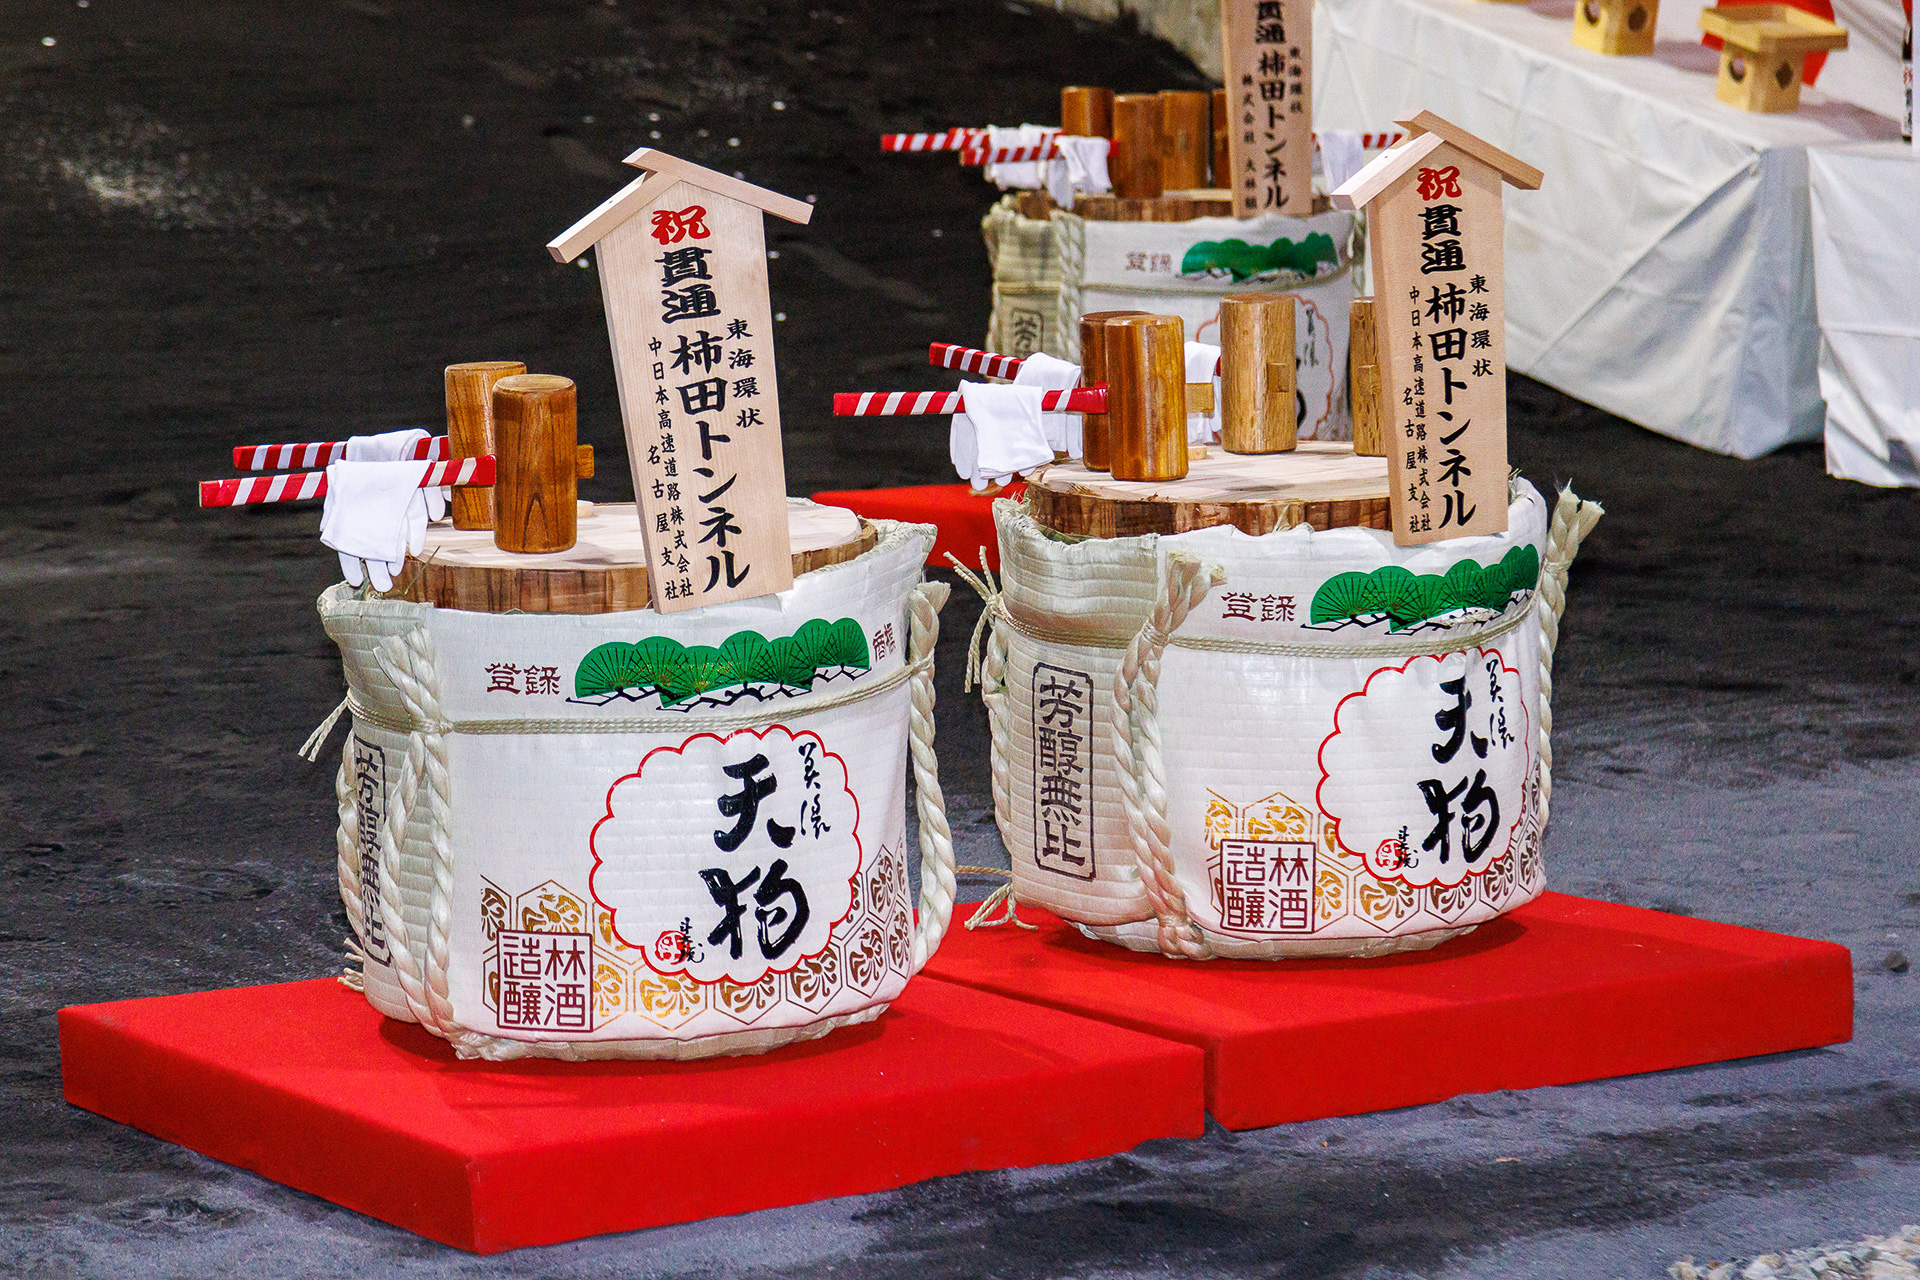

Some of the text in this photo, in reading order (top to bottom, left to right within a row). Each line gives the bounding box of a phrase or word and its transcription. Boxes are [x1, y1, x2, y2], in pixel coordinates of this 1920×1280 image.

[726, 318, 764, 430] 東海環状
[1408, 286, 1432, 533] 中日本高速道路株式会社
[1468, 274, 1493, 377] 東海環状
[647, 334, 695, 600] 中日本高速道路株式会社
[647, 445, 680, 600] 名古屋支社
[1402, 387, 1420, 533] 名古屋支社
[1417, 675, 1500, 864] 天狗
[700, 753, 810, 960] 天狗
